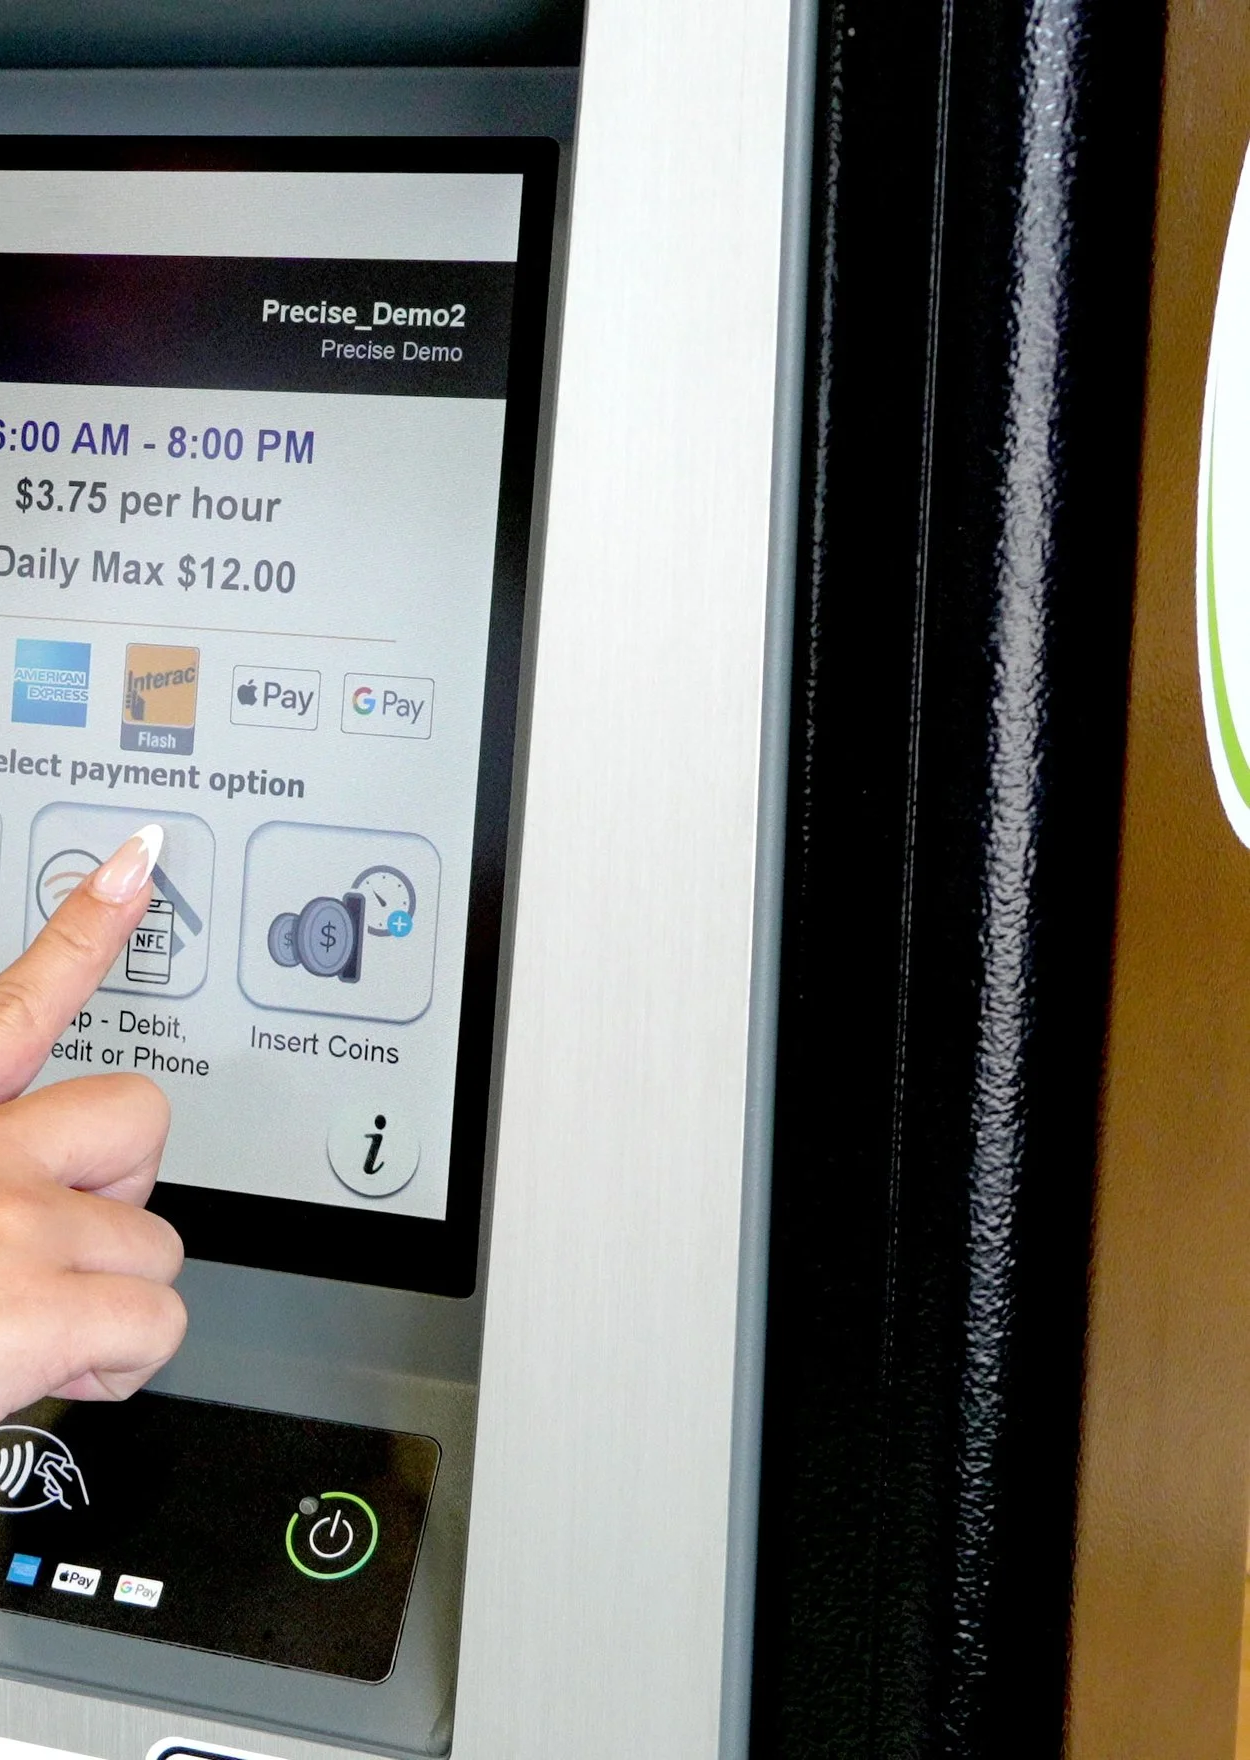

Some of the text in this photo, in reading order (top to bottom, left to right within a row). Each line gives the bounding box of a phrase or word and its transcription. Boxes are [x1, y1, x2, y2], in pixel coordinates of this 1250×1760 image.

[262, 299, 466, 331] Precise_Demo2
[321, 339, 463, 362] Precise Demo
[71, 422, 130, 456] AM
[167, 426, 244, 461] 8:00
[257, 429, 315, 464] PM
[15, 476, 282, 524] $3.75 per hour
[92, 550, 165, 586] Max
[177, 553, 296, 594] $12.00
[14, 668, 86, 686] AMERICAN
[127, 667, 196, 693] Interac
[29, 686, 89, 703] EXPRESS
[263, 682, 314, 716] Pay
[382, 690, 425, 725] Pay
[138, 731, 176, 749] Flash
[70, 759, 200, 789] payment
[209, 769, 305, 798] option
[135, 931, 165, 950] NFC
[119, 1010, 186, 1042] Debit,
[51, 1038, 209, 1076] edit or Phone
[251, 1026, 399, 1064] Insert Coins
[68, 1572, 94, 1589] Pay
[134, 1584, 158, 1601] Pay
